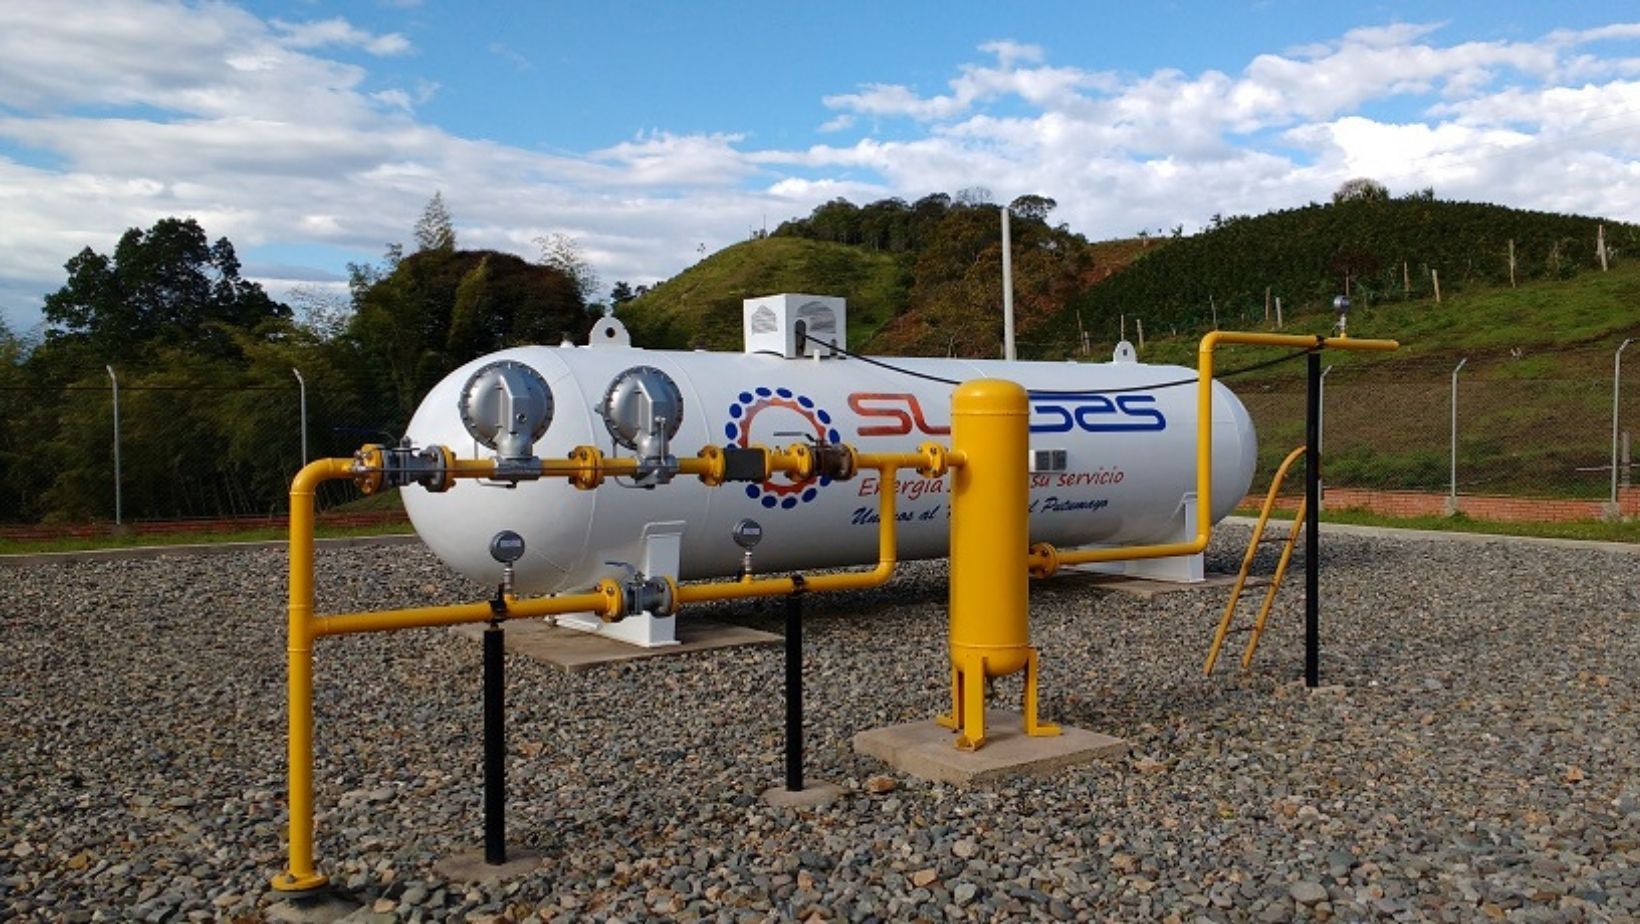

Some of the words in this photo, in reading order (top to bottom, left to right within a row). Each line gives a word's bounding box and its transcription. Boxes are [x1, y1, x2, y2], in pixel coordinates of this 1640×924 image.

[1030, 474, 1050, 489] su
[1056, 465, 1124, 487] servicio
[918, 503, 941, 520] al
[1040, 495, 1109, 512] Putumayo
